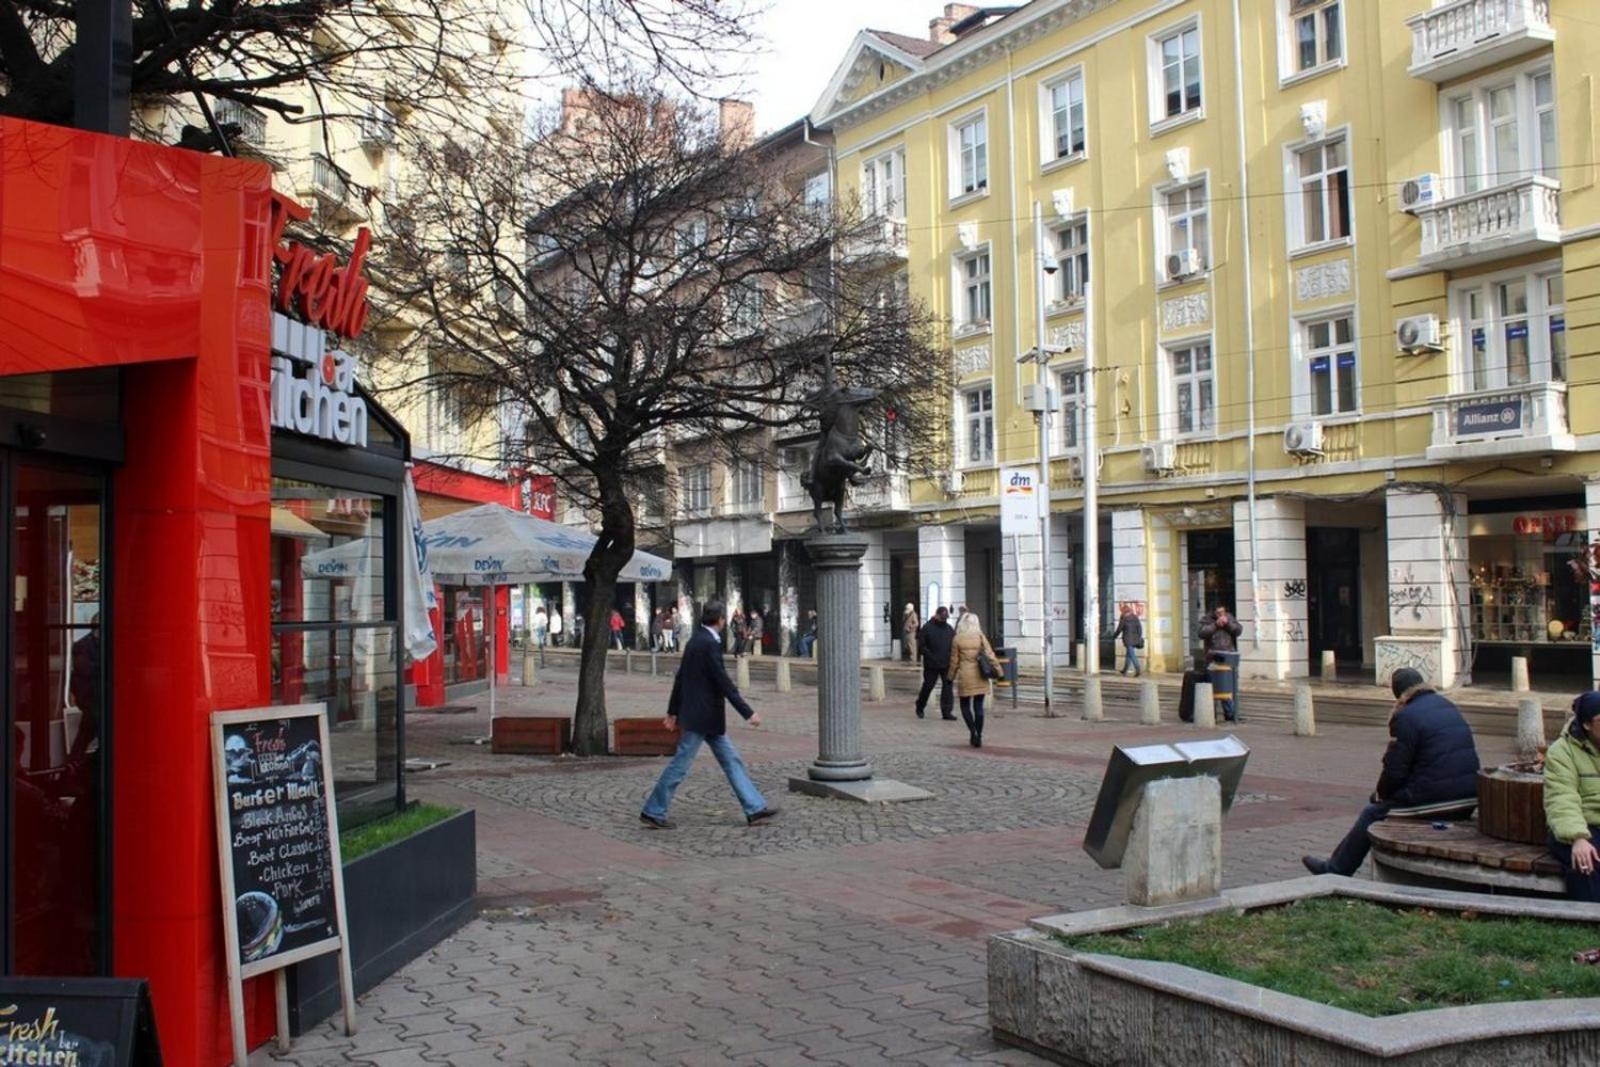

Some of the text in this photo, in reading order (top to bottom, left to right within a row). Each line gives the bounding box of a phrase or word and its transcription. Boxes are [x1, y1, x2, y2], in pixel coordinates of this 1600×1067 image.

[271, 357, 367, 448] itchen
[1464, 412, 1499, 426] Allianz
[1010, 472, 1031, 486] dm
[475, 556, 504, 571] DEVIN
